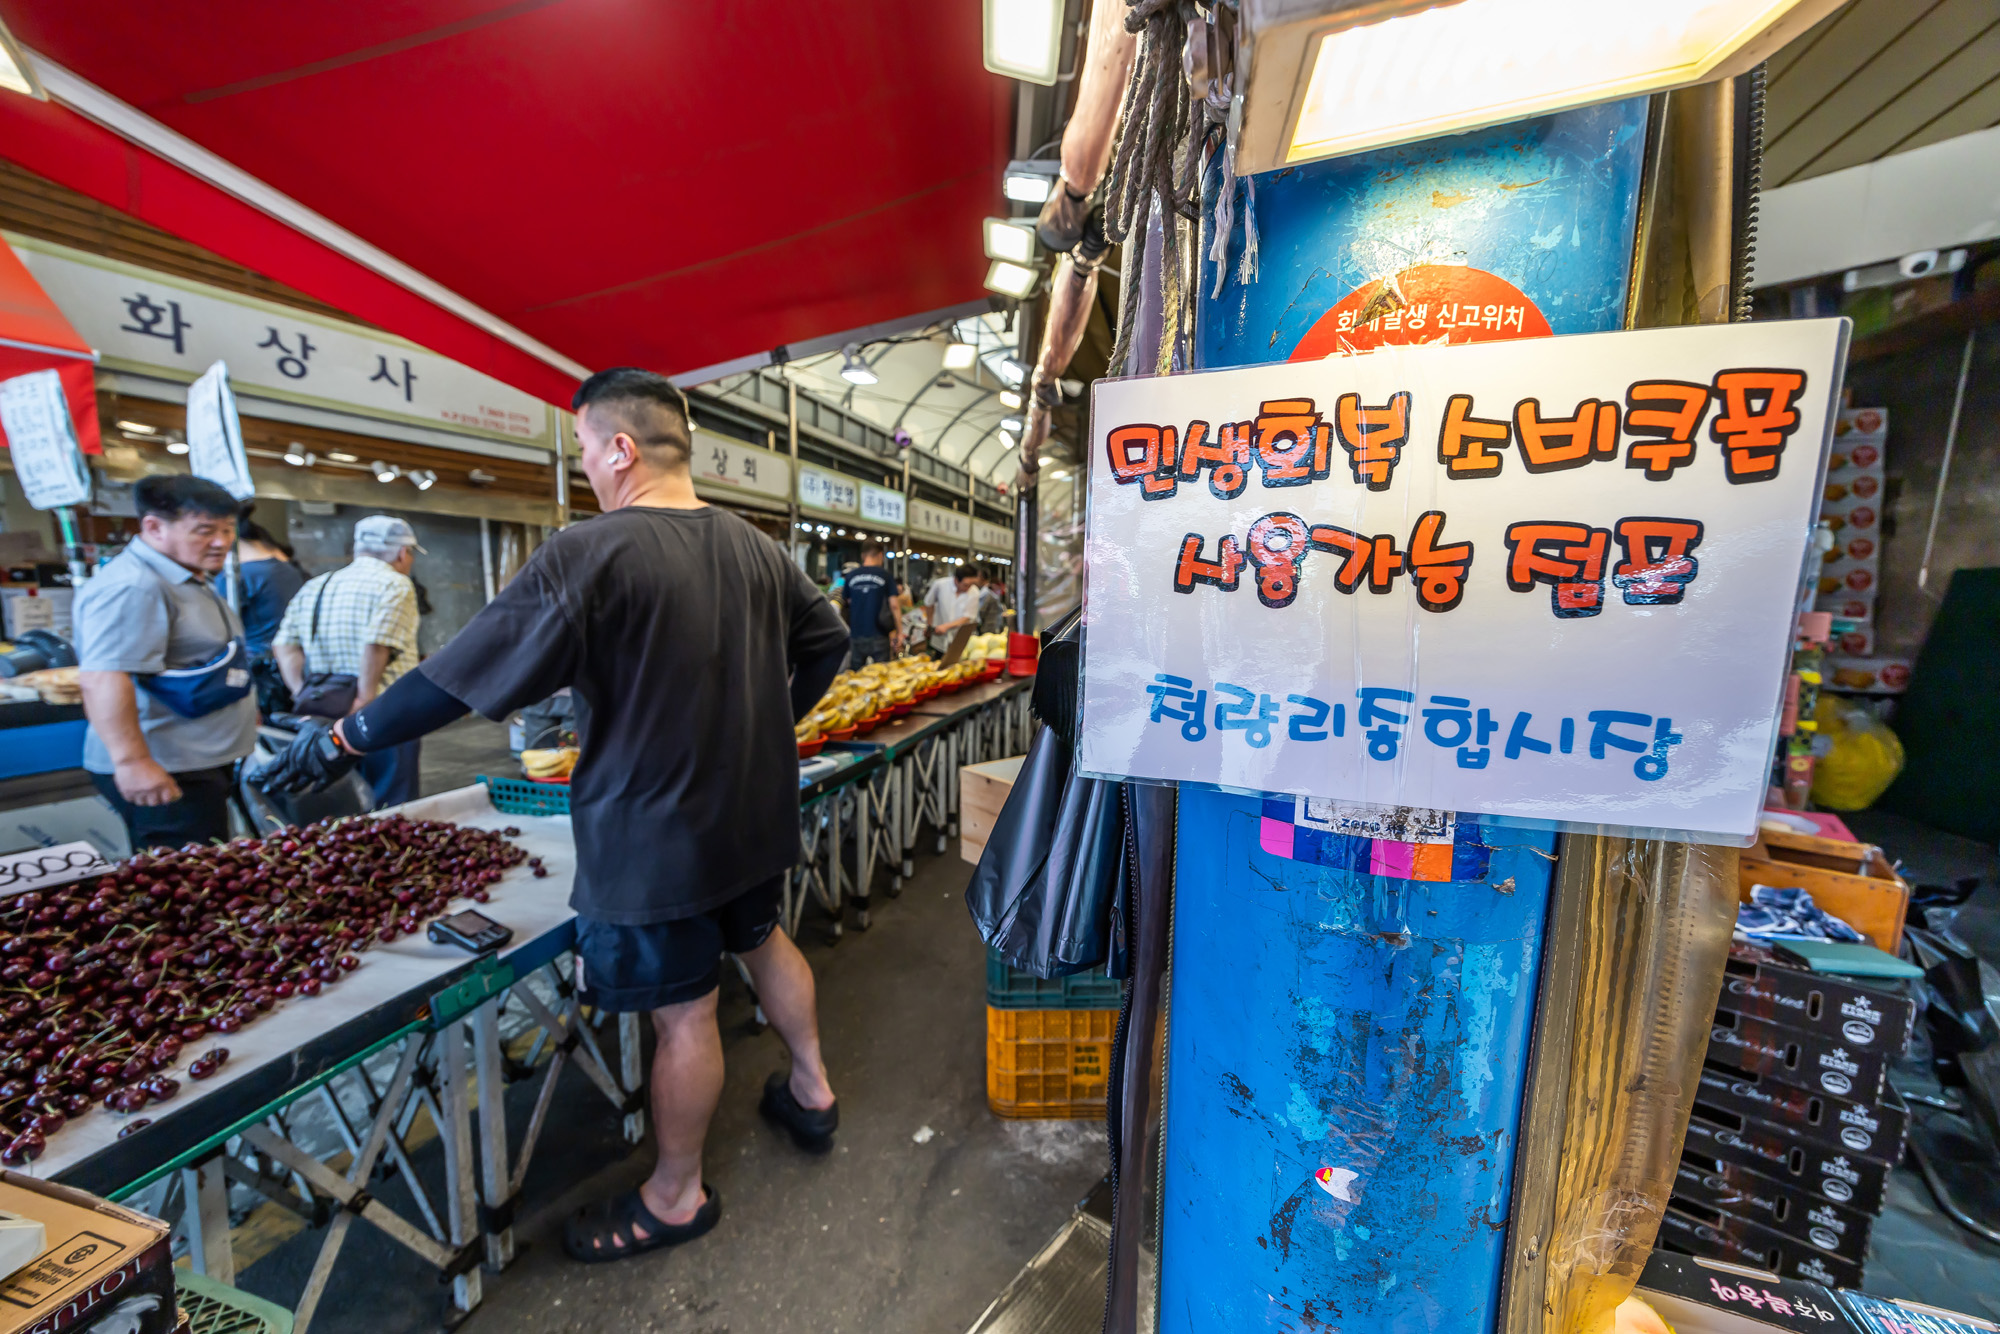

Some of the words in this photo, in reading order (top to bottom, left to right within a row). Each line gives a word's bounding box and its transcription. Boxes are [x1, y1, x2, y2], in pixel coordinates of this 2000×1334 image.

[1436, 303, 1525, 333] 신고위치
[1106, 391, 1412, 500] 민생회복
[1438, 367, 1807, 484] 소비쿠폰
[1173, 510, 1474, 613] 사용가능
[1504, 516, 1704, 618] 점포
[1146, 673, 1684, 782] 청량리종합시장
[1710, 1277, 1795, 1317] 복숭아
[1794, 1294, 1835, 1322] 여주
